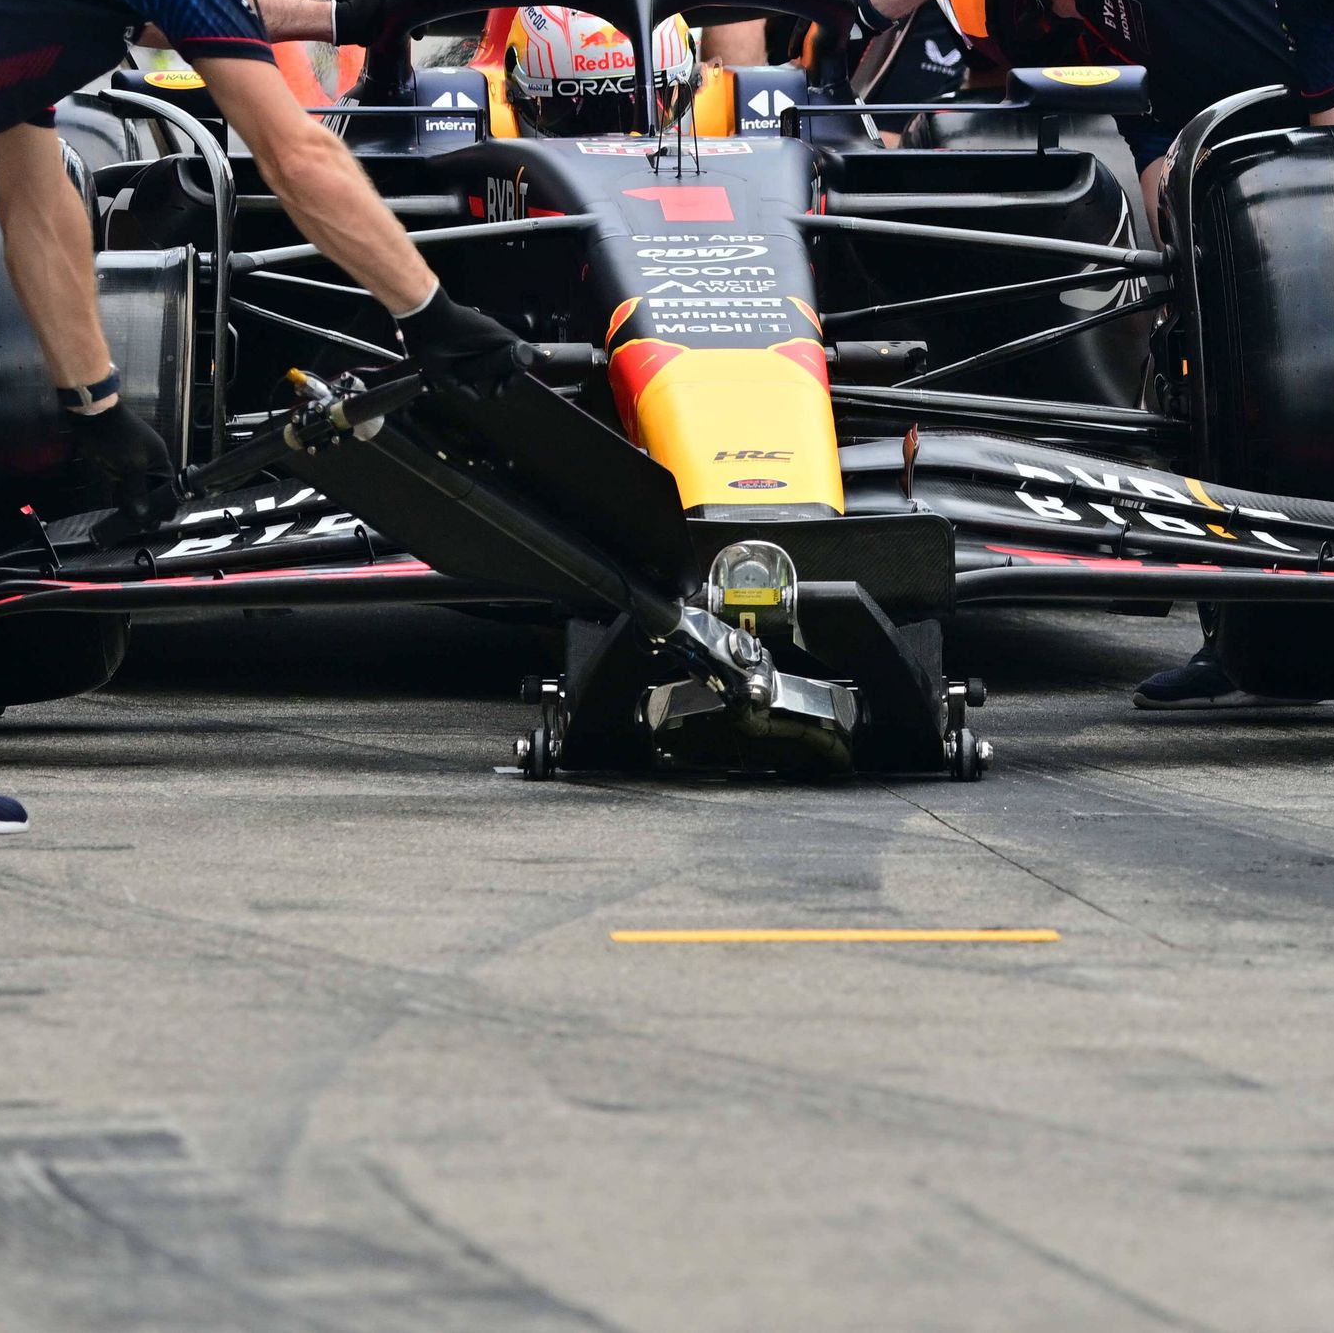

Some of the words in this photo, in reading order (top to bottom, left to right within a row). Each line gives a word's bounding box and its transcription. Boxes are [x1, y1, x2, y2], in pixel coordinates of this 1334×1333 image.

[574, 52, 610, 71] Red
[612, 52, 635, 69] Bu
[557, 72, 664, 96] ORACE
[425, 119, 476, 132] inter.m
[741, 119, 801, 130] inter.
[621, 186, 735, 223] 1
[632, 234, 700, 242] Cash
[707, 234, 765, 243] App
[637, 246, 744, 258] CDW
[640, 267, 775, 276] zoom
[648, 298, 783, 307] PIRELLI
[655, 323, 752, 333] Mobil
[714, 450, 794, 461] HRC
